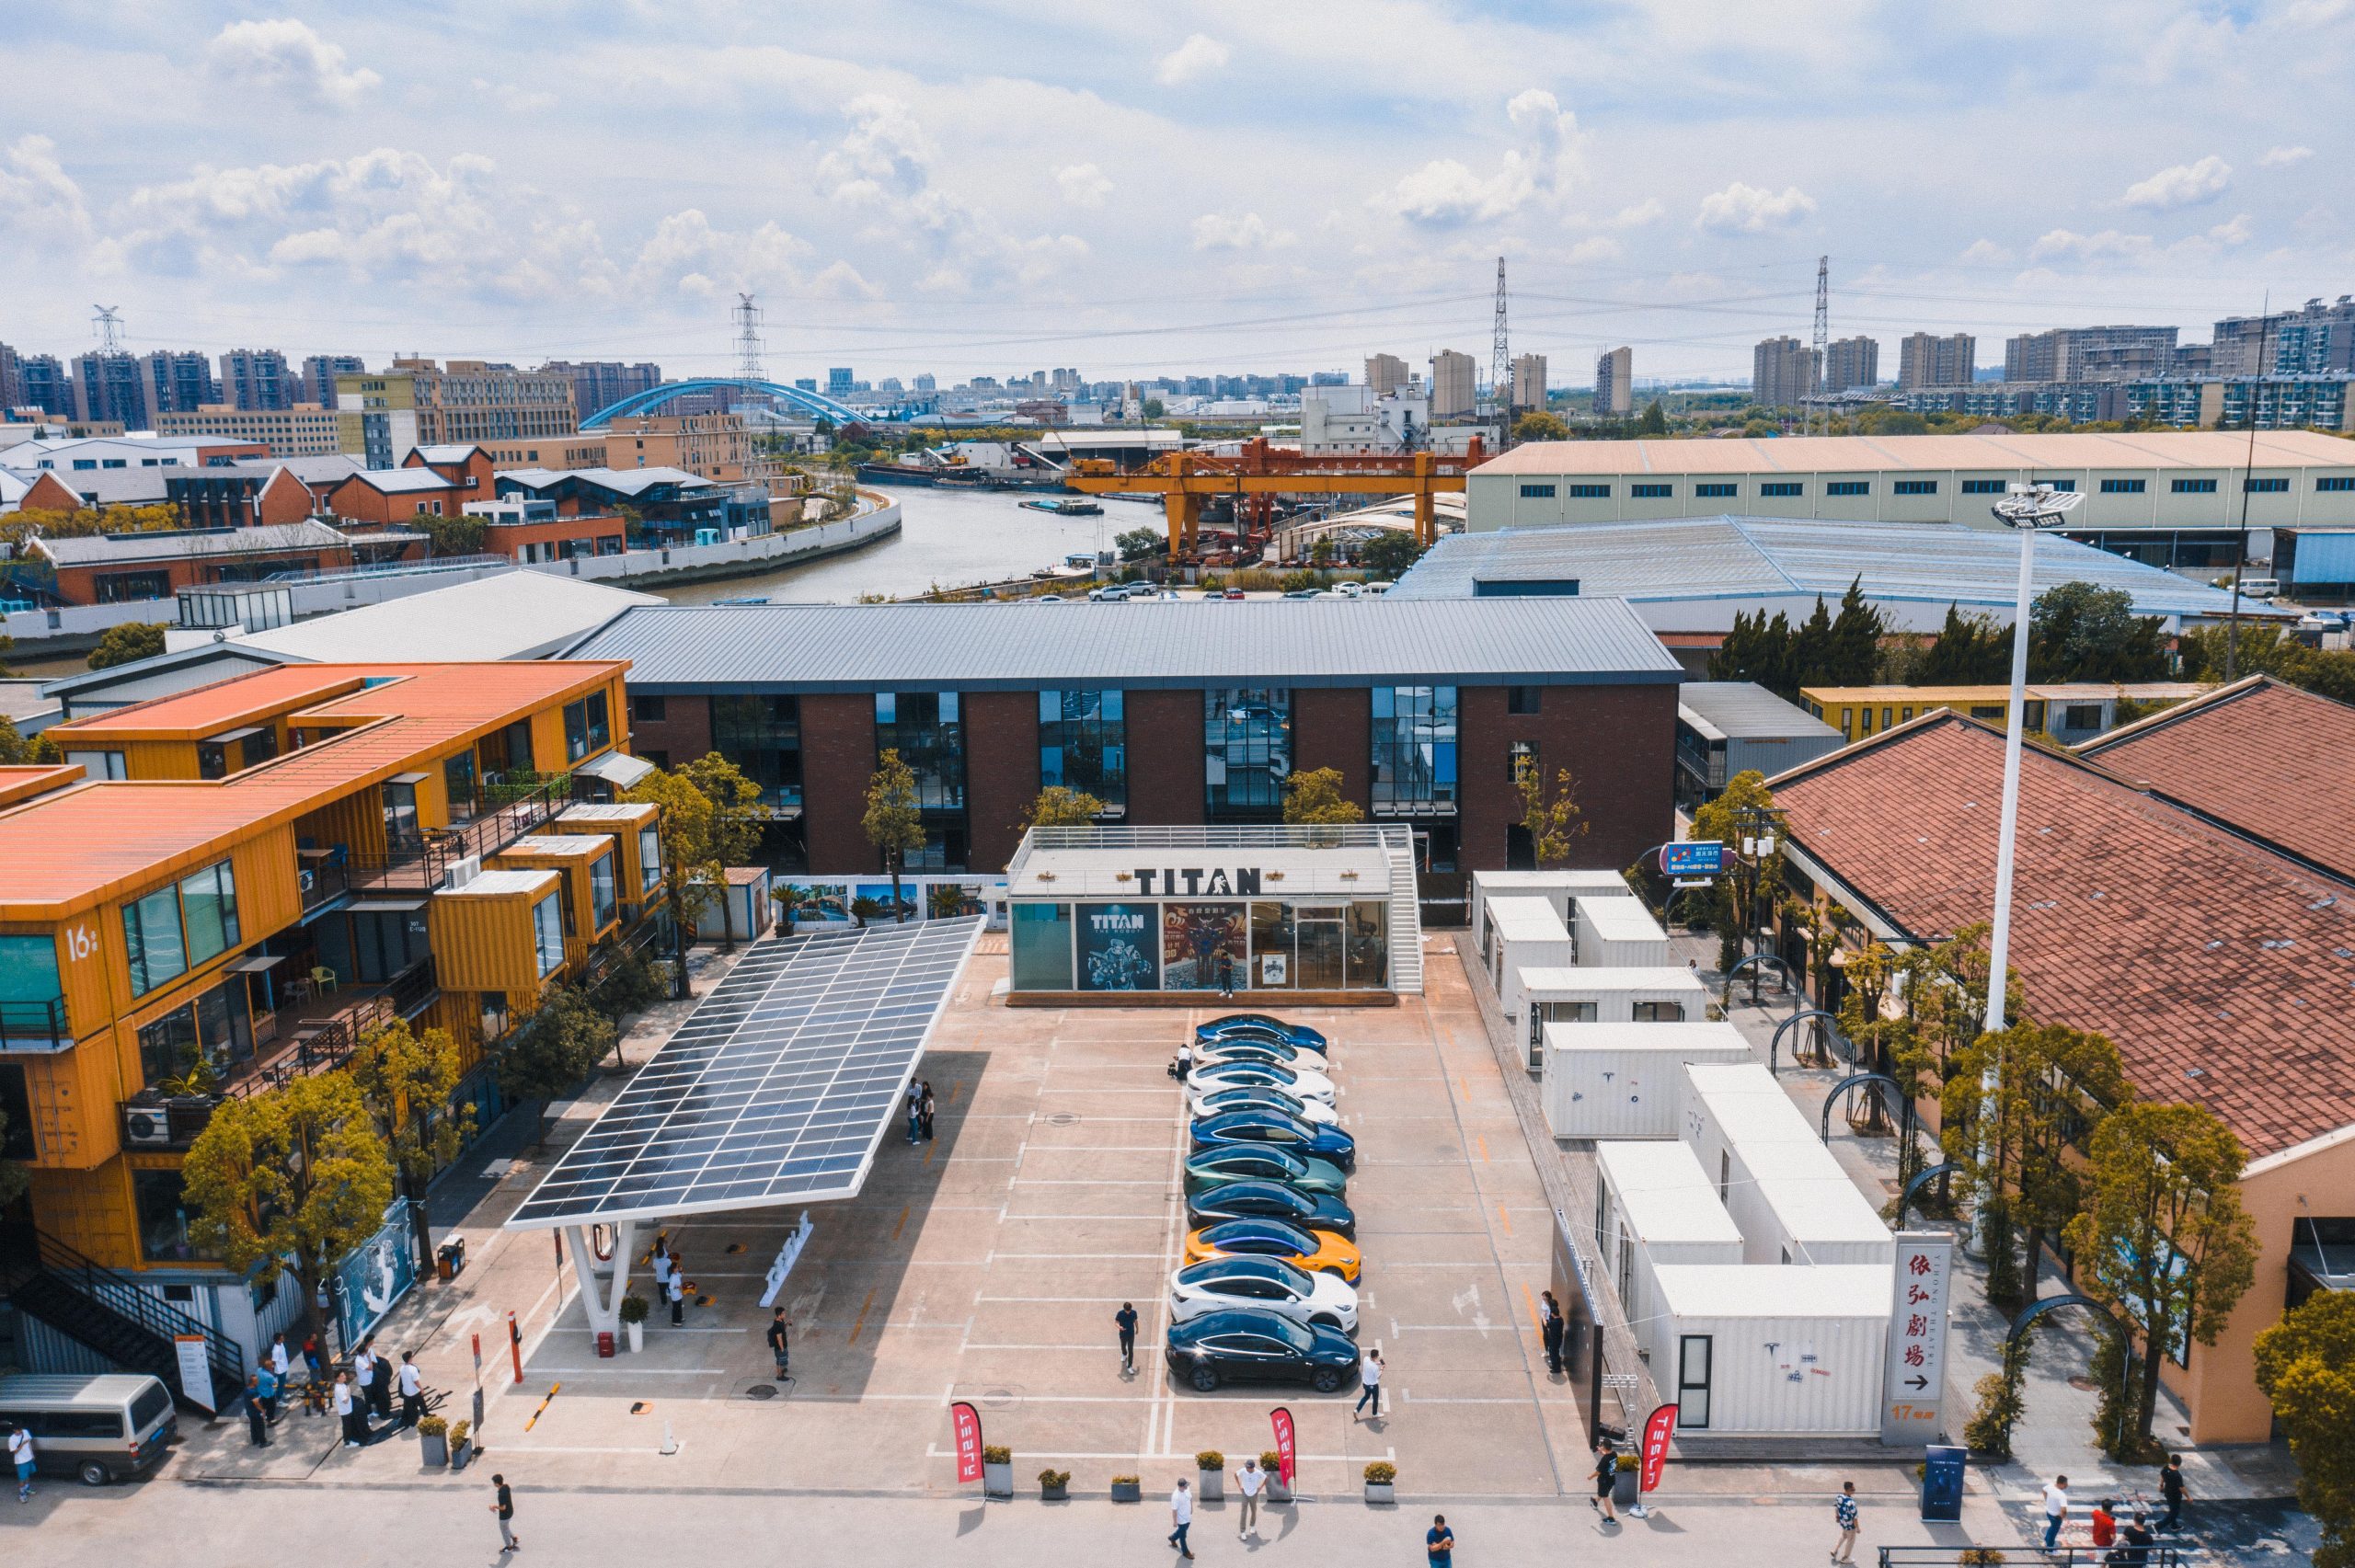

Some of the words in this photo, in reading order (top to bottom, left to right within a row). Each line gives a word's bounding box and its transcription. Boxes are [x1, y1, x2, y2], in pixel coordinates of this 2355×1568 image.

[1134, 868, 1260, 896] TITAN
[1091, 915, 1143, 929] TITAN
[1930, 1254, 1941, 1304] YIHONG
[1904, 1254, 1931, 1368] 依弘劇場
[1927, 1310, 1937, 1368] THEATRE
[1648, 1416, 1669, 1484] TESLA
